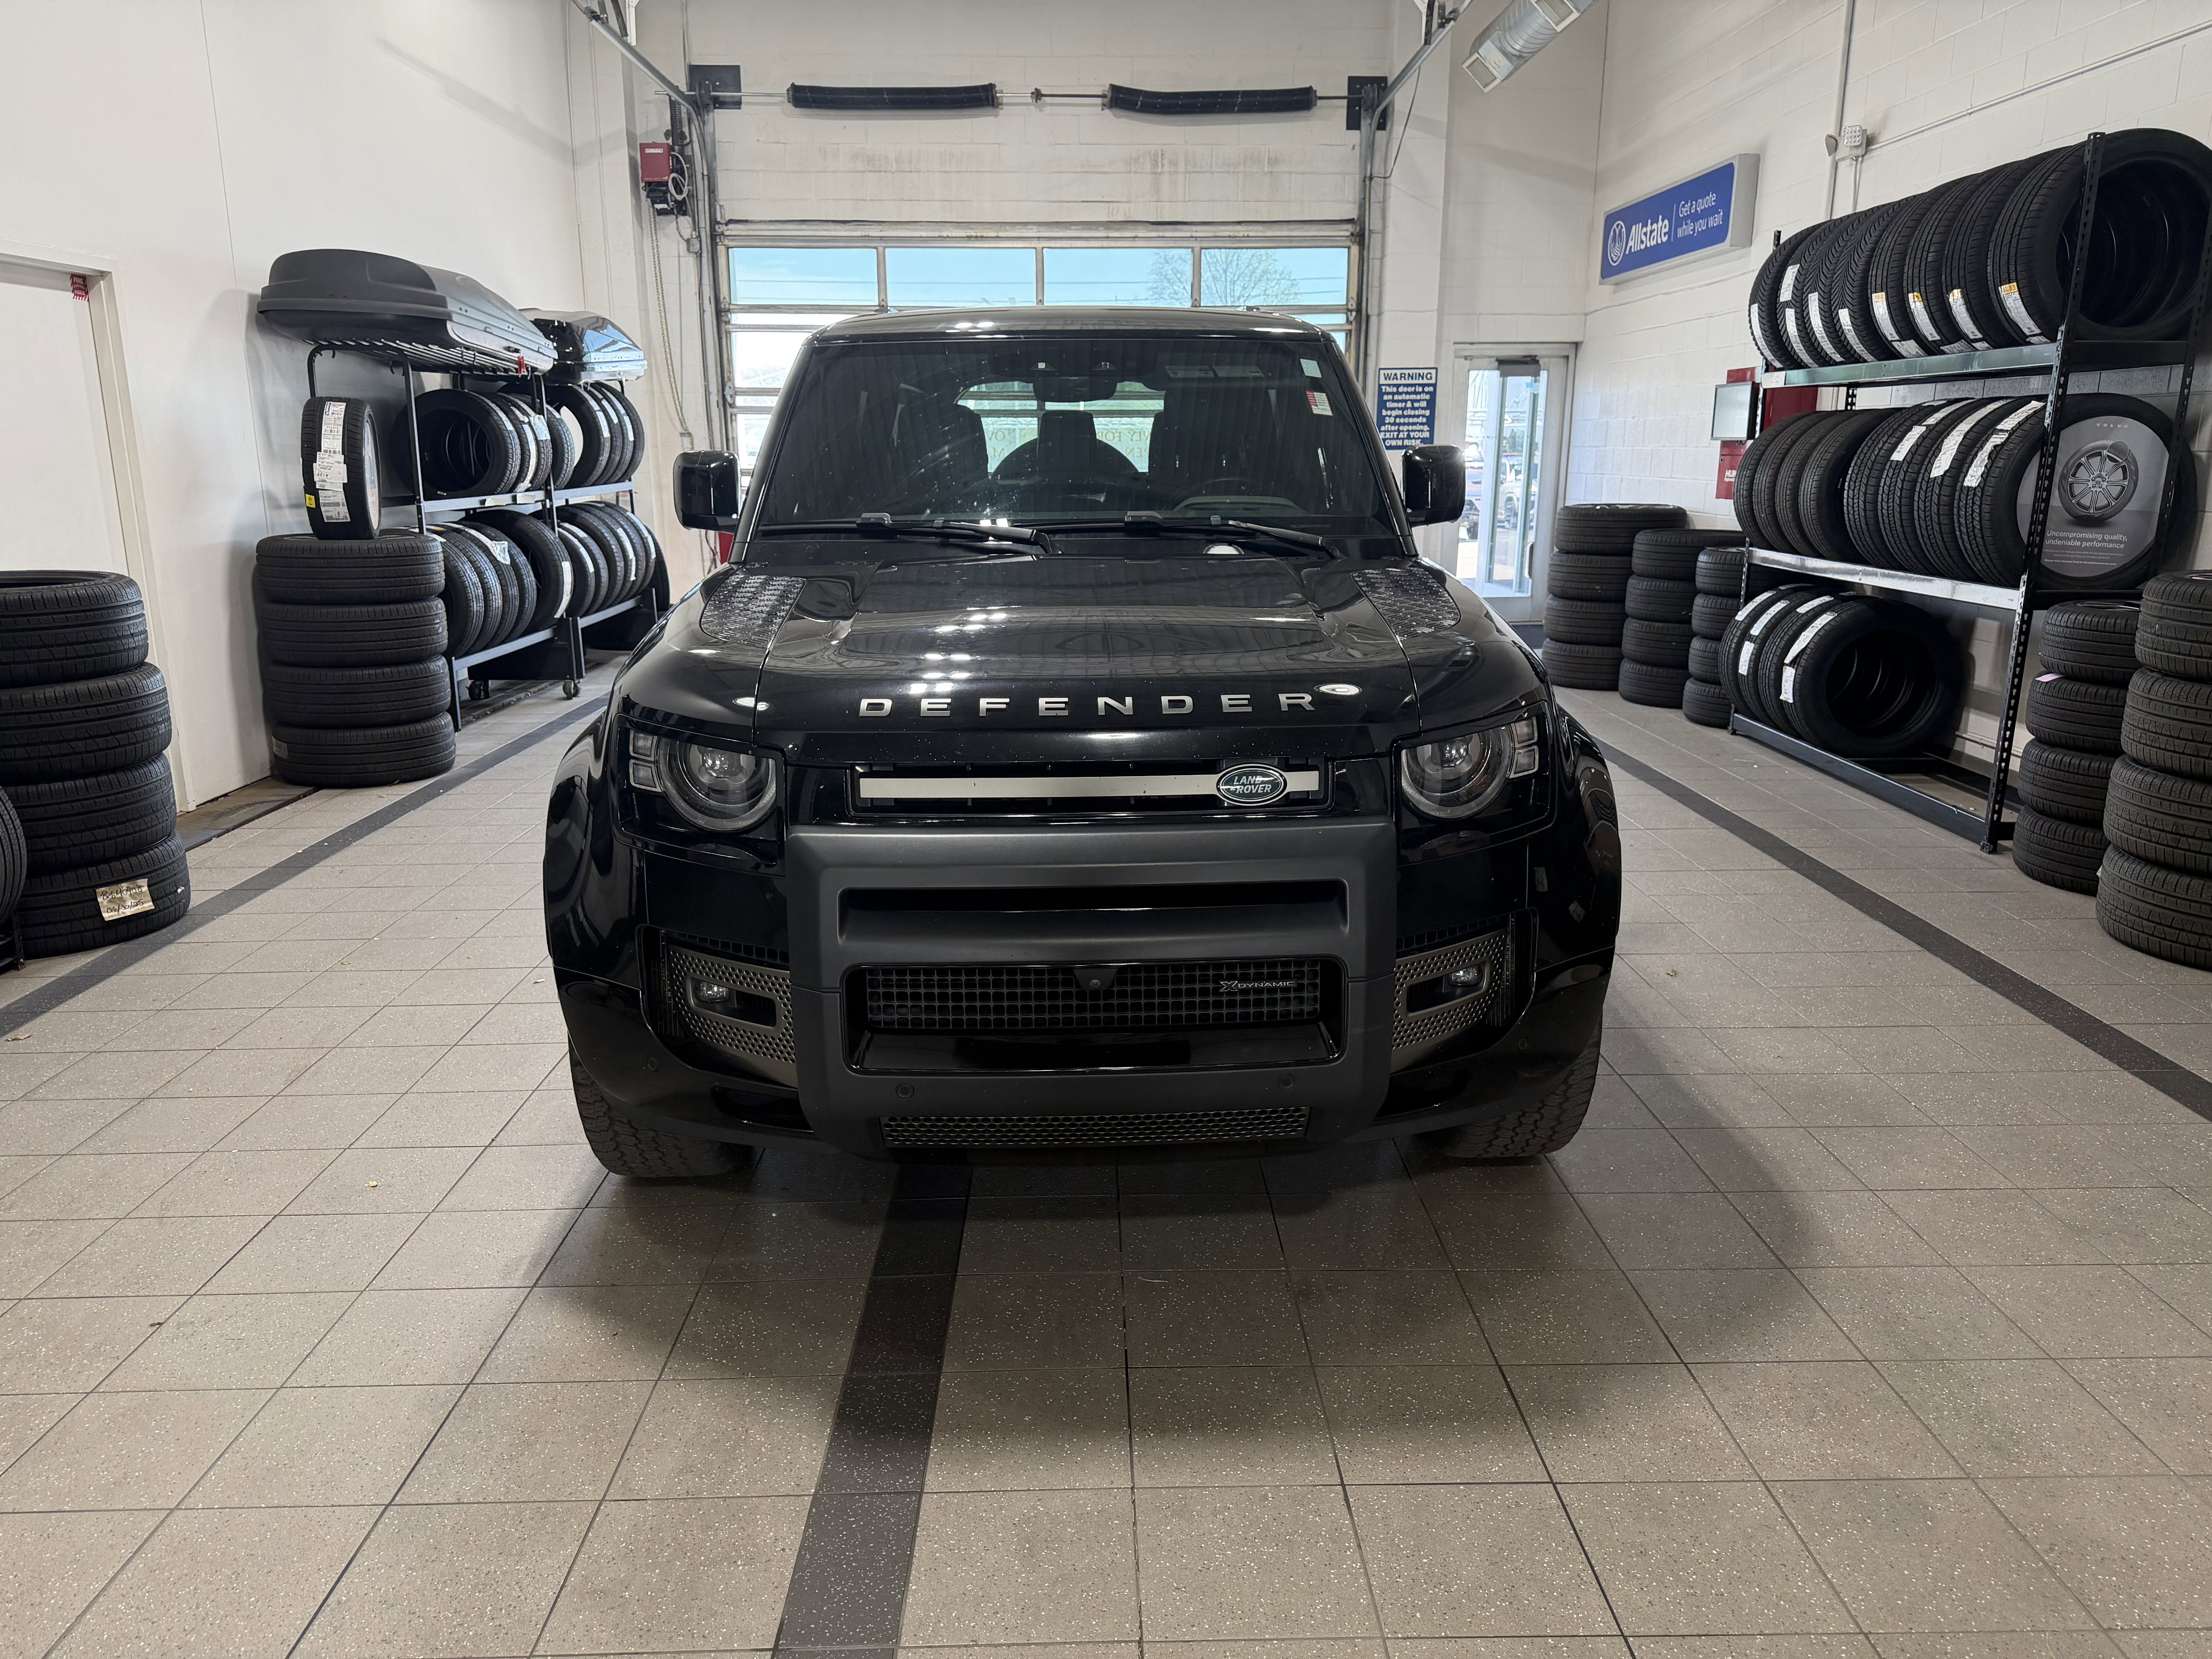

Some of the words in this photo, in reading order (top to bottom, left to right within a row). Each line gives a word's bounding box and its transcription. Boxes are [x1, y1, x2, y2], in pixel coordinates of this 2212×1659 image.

[1679, 200, 1691, 217] Get
[1691, 201, 1696, 213] a
[1697, 191, 1716, 213] quote
[1677, 219, 1694, 238] while
[1694, 218, 1707, 236] you
[1708, 209, 1723, 228] wait
[1626, 215, 1669, 254] Allstate
[1383, 372, 1432, 381] WARNING
[2047, 530, 2102, 540] Uncompromising
[2104, 534, 2128, 542] quality,
[859, 693, 1315, 717] DEFENDER
[1233, 776, 1262, 785] LAND
[1236, 784, 1272, 793] ROVER
[106, 898, 144, 913] 06/30/25
